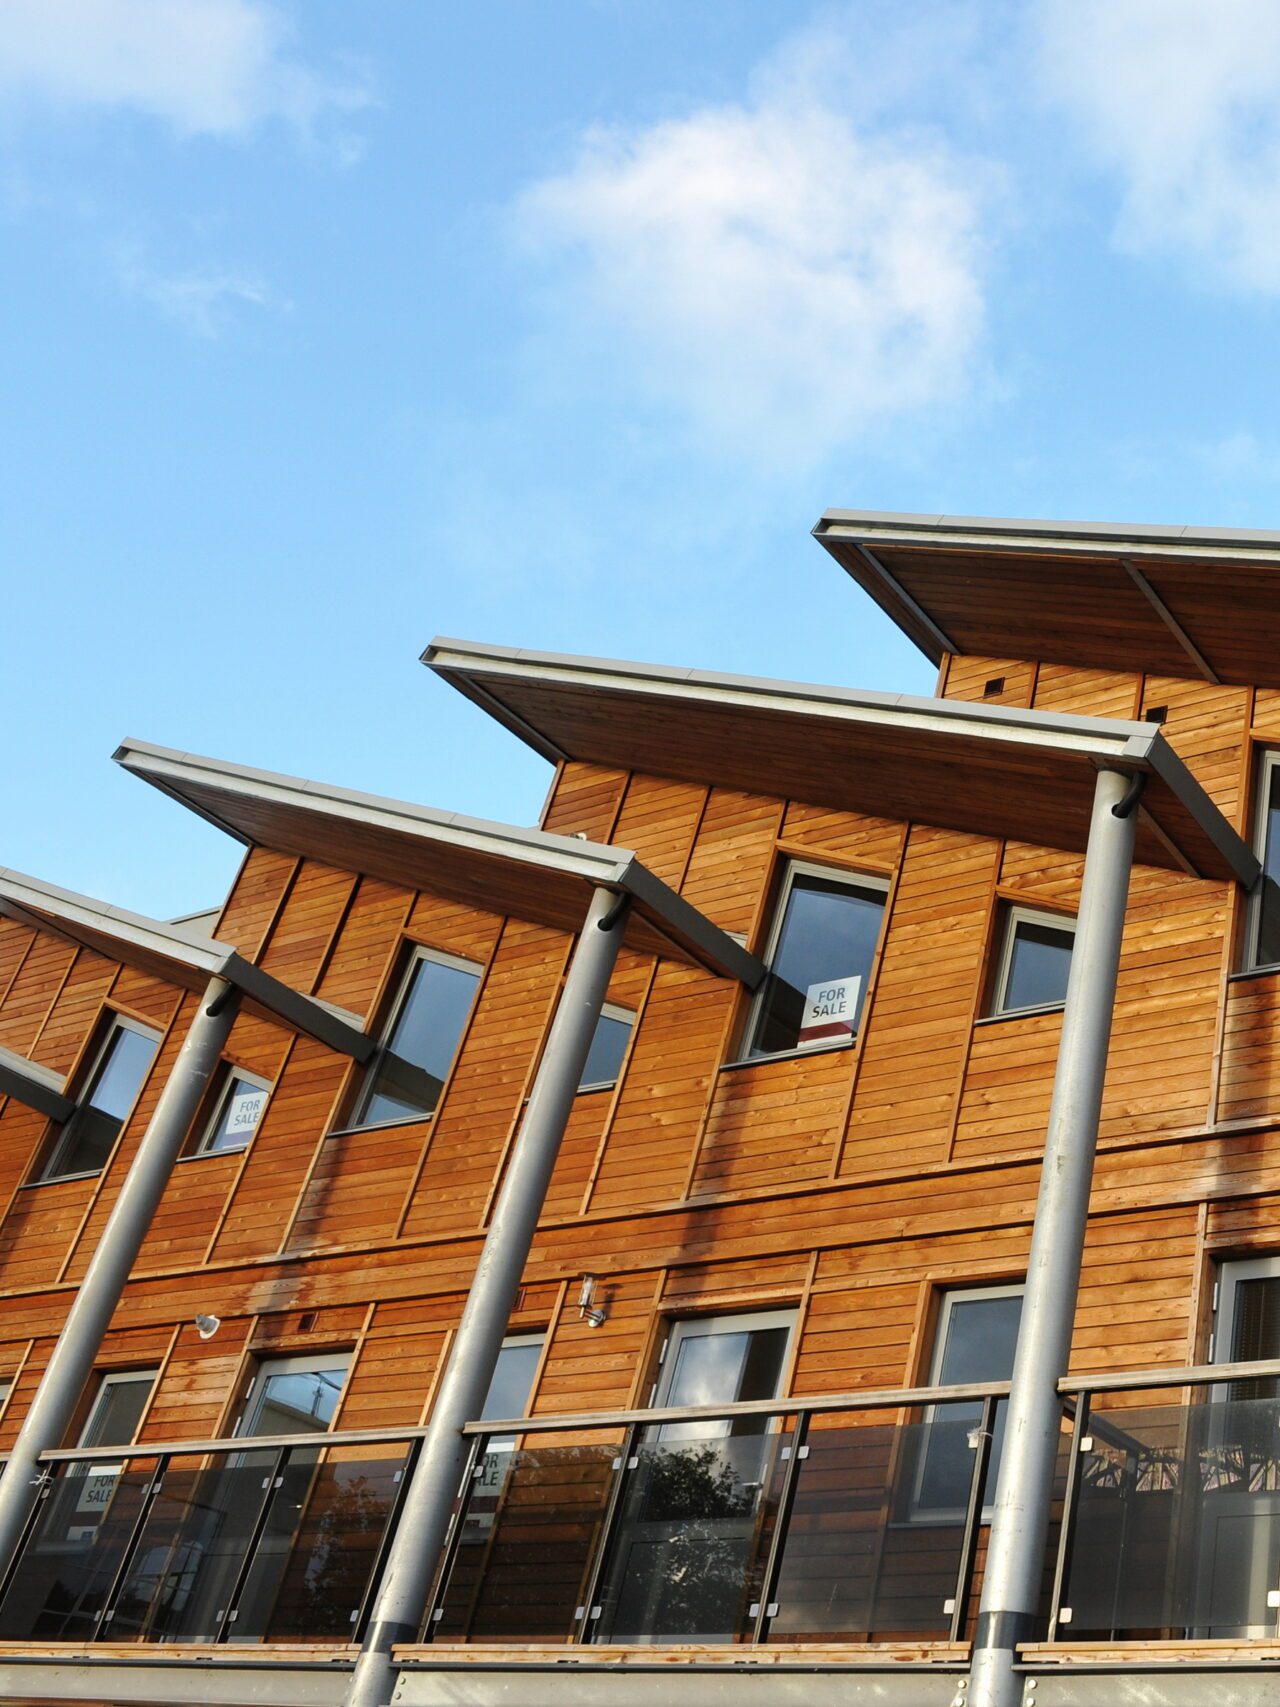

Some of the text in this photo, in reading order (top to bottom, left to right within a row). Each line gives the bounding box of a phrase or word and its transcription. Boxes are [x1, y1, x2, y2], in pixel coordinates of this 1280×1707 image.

[818, 987, 846, 1003] FOR
[811, 1001, 847, 1019] SALE
[240, 1099, 260, 1112] FOR
[234, 1111, 260, 1126] SALE
[94, 1475, 116, 1488] FOR
